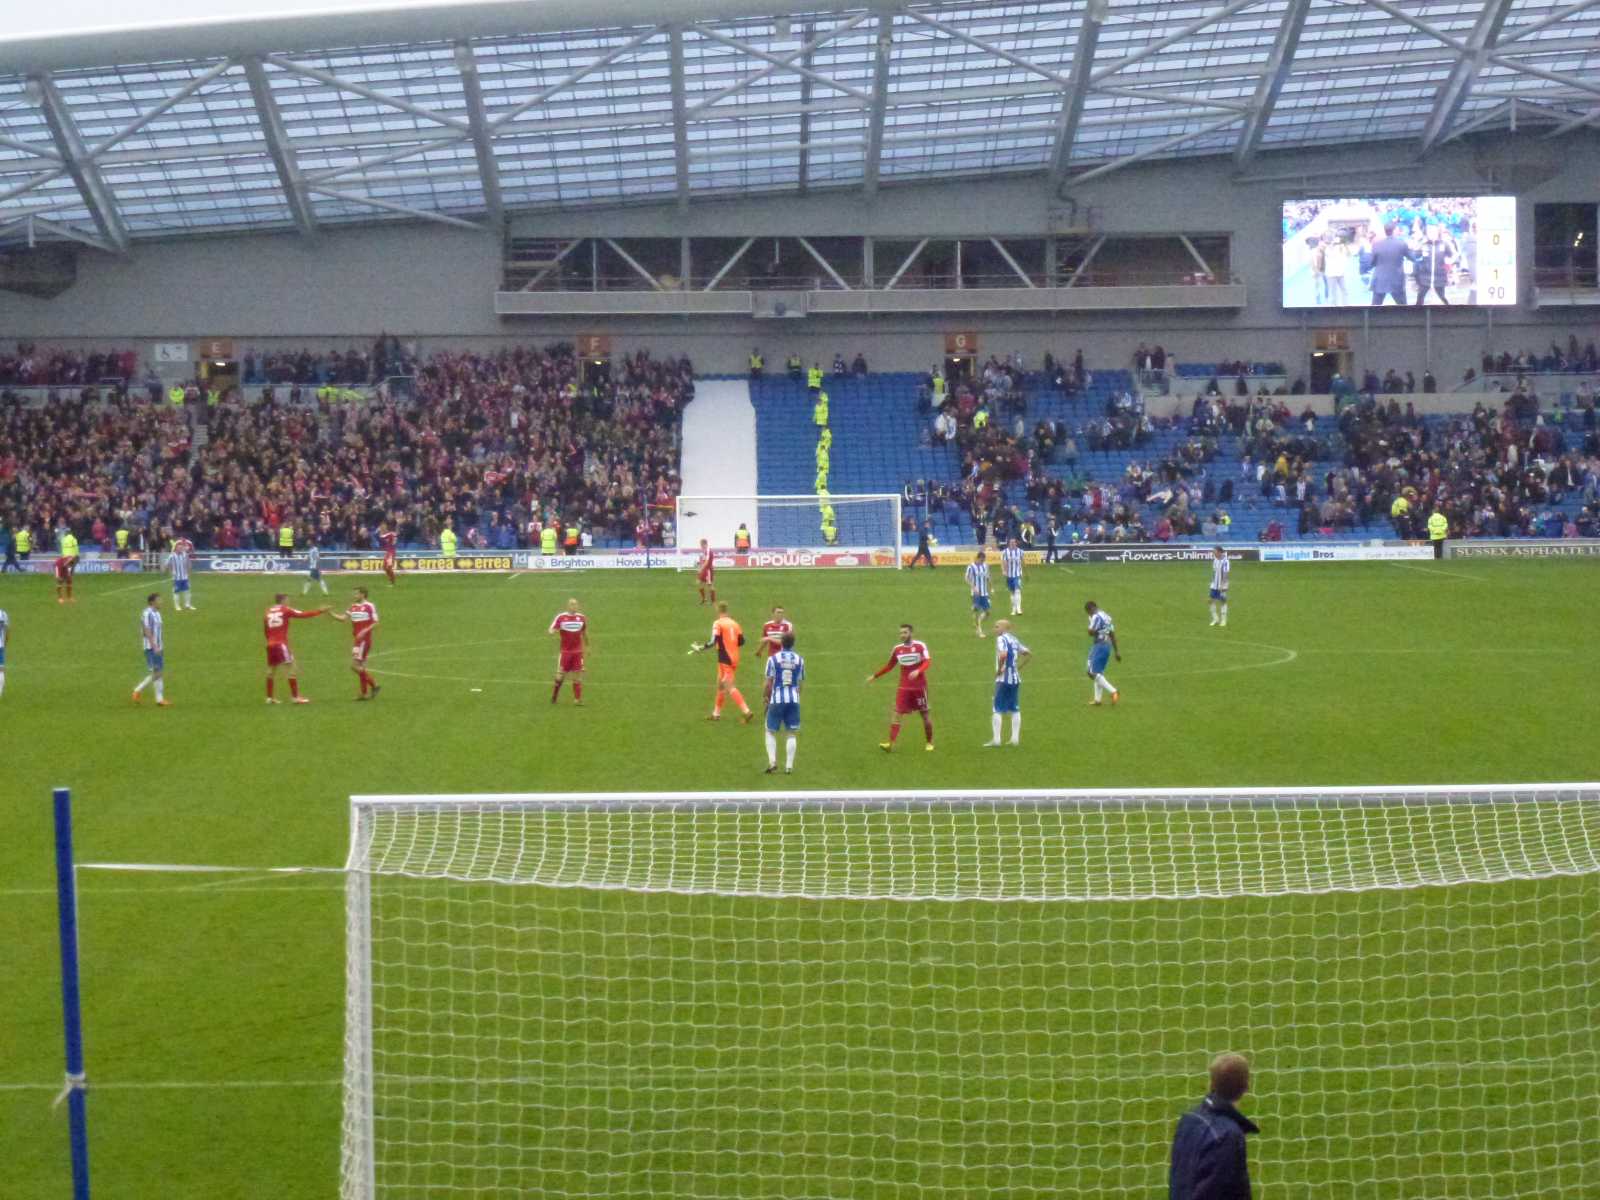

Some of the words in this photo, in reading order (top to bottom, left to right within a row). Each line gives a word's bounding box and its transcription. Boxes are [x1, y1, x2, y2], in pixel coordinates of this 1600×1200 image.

[1492, 233, 1501, 246] 0
[1488, 286, 1505, 299] 90
[591, 336, 600, 350] F
[955, 334, 966, 348] G
[212, 342, 221, 354] E
[1286, 551, 1311, 562] Light
[1313, 551, 1335, 560] Bros
[1456, 547, 1506, 557] SUSSEX
[418, 558, 454, 570] errea
[474, 557, 510, 570] errea
[550, 558, 595, 571] Brighton
[616, 557, 642, 567] Hove
[643, 556, 667, 567] Jobs
[746, 551, 821, 567] npower
